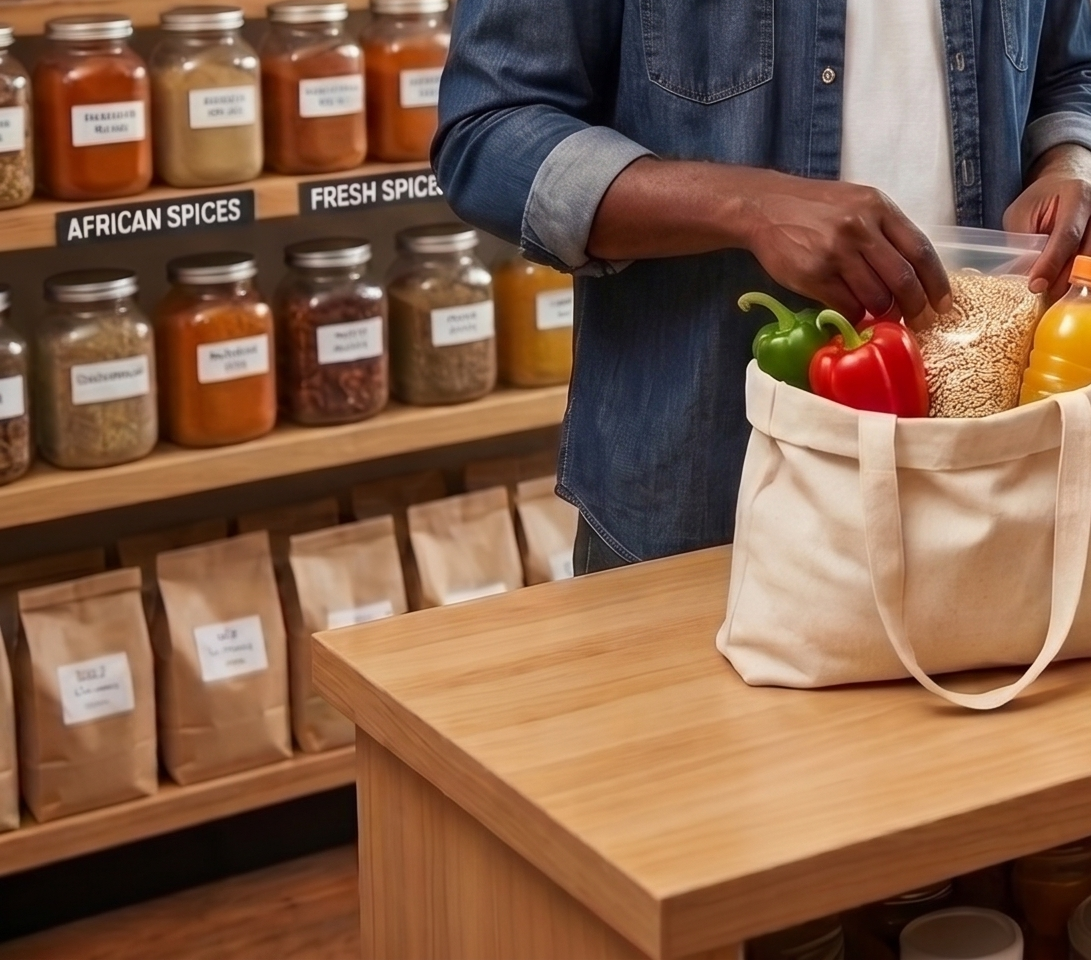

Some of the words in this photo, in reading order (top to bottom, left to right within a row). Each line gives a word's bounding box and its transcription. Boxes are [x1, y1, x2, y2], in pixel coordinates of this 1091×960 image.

[311, 181, 377, 210] FRESH
[381, 174, 443, 202] SPICE
[66, 207, 162, 241] AFRICAN
[166, 198, 241, 228] SPICES
